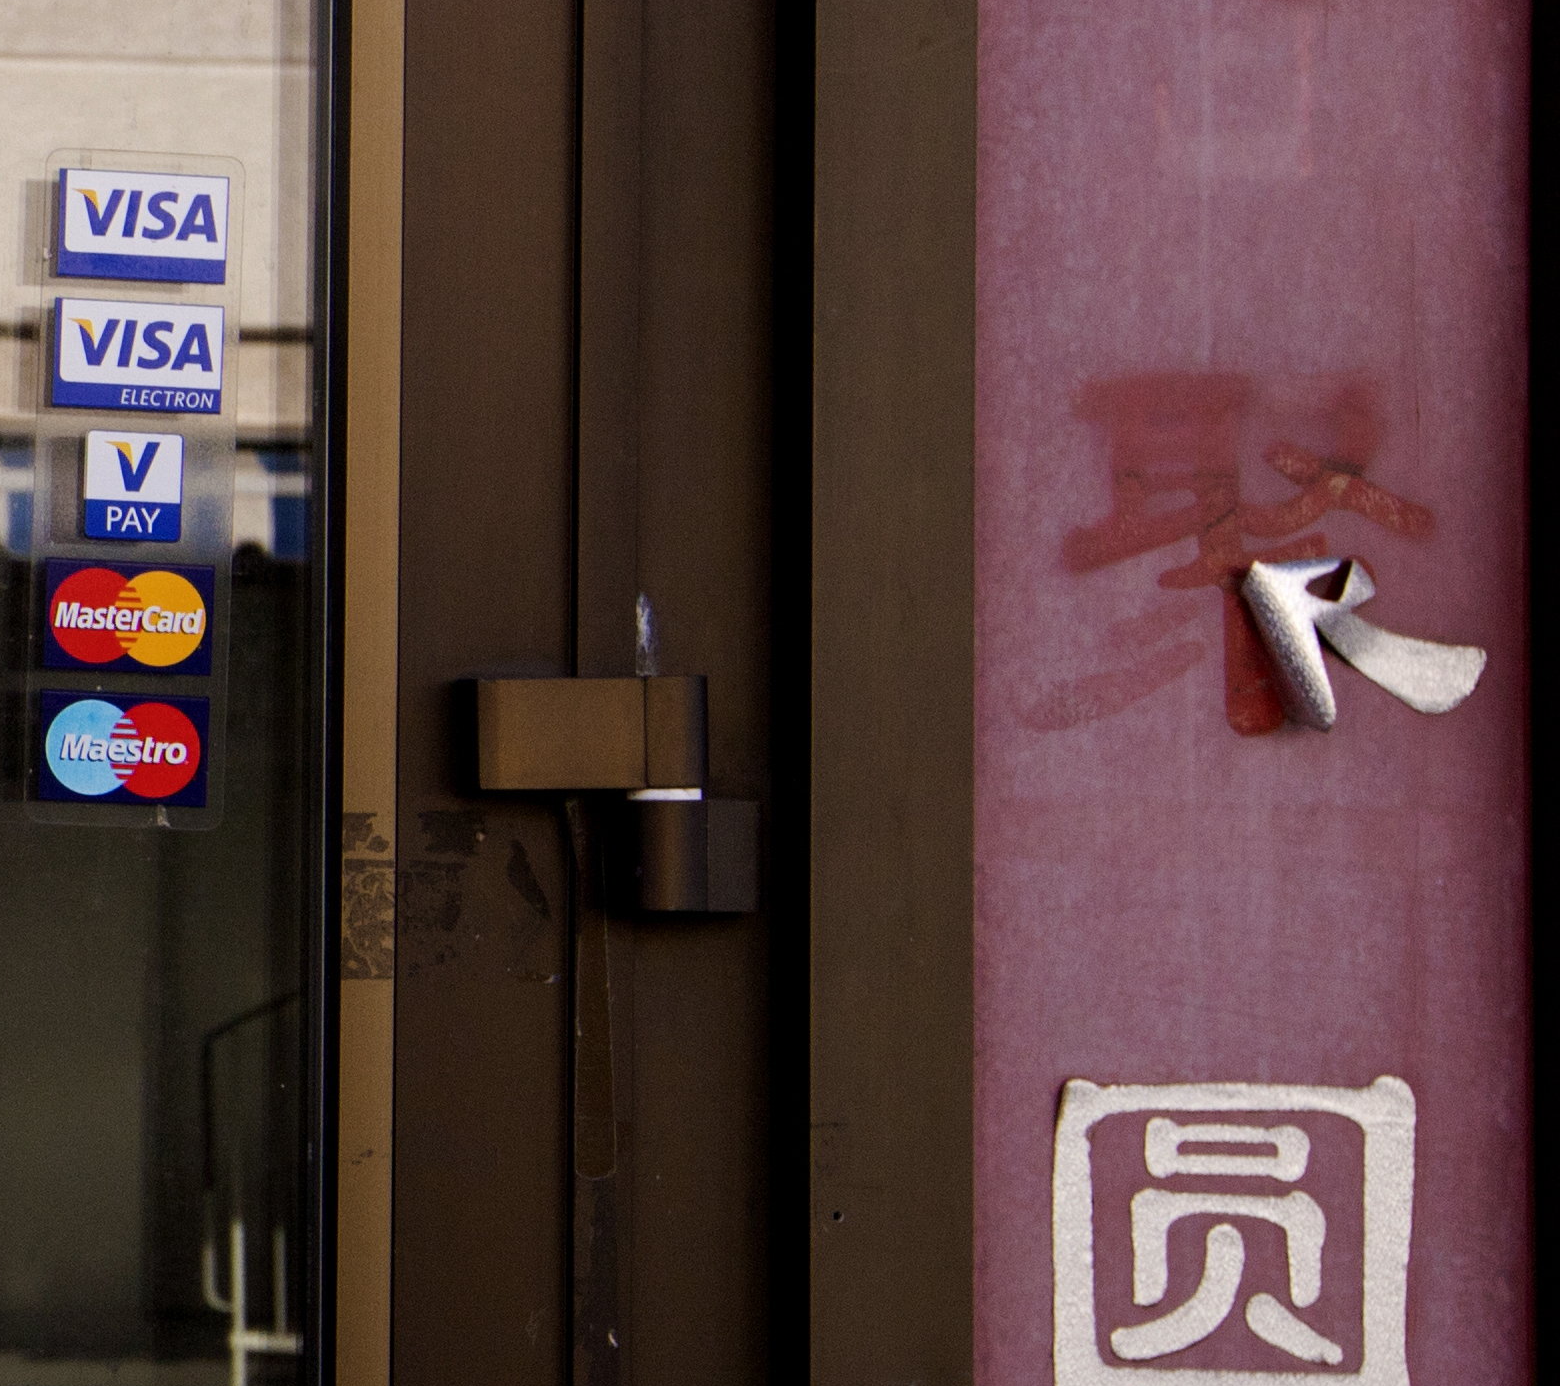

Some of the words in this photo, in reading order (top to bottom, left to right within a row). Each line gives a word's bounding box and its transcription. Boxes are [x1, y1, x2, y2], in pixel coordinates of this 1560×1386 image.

[73, 187, 219, 244] VISA
[69, 317, 214, 374] VISA
[117, 387, 217, 411] ELECTRON
[106, 440, 162, 493] V
[105, 504, 162, 535] PAY
[52, 599, 207, 637] MasterCard
[57, 731, 190, 767] Maestro
